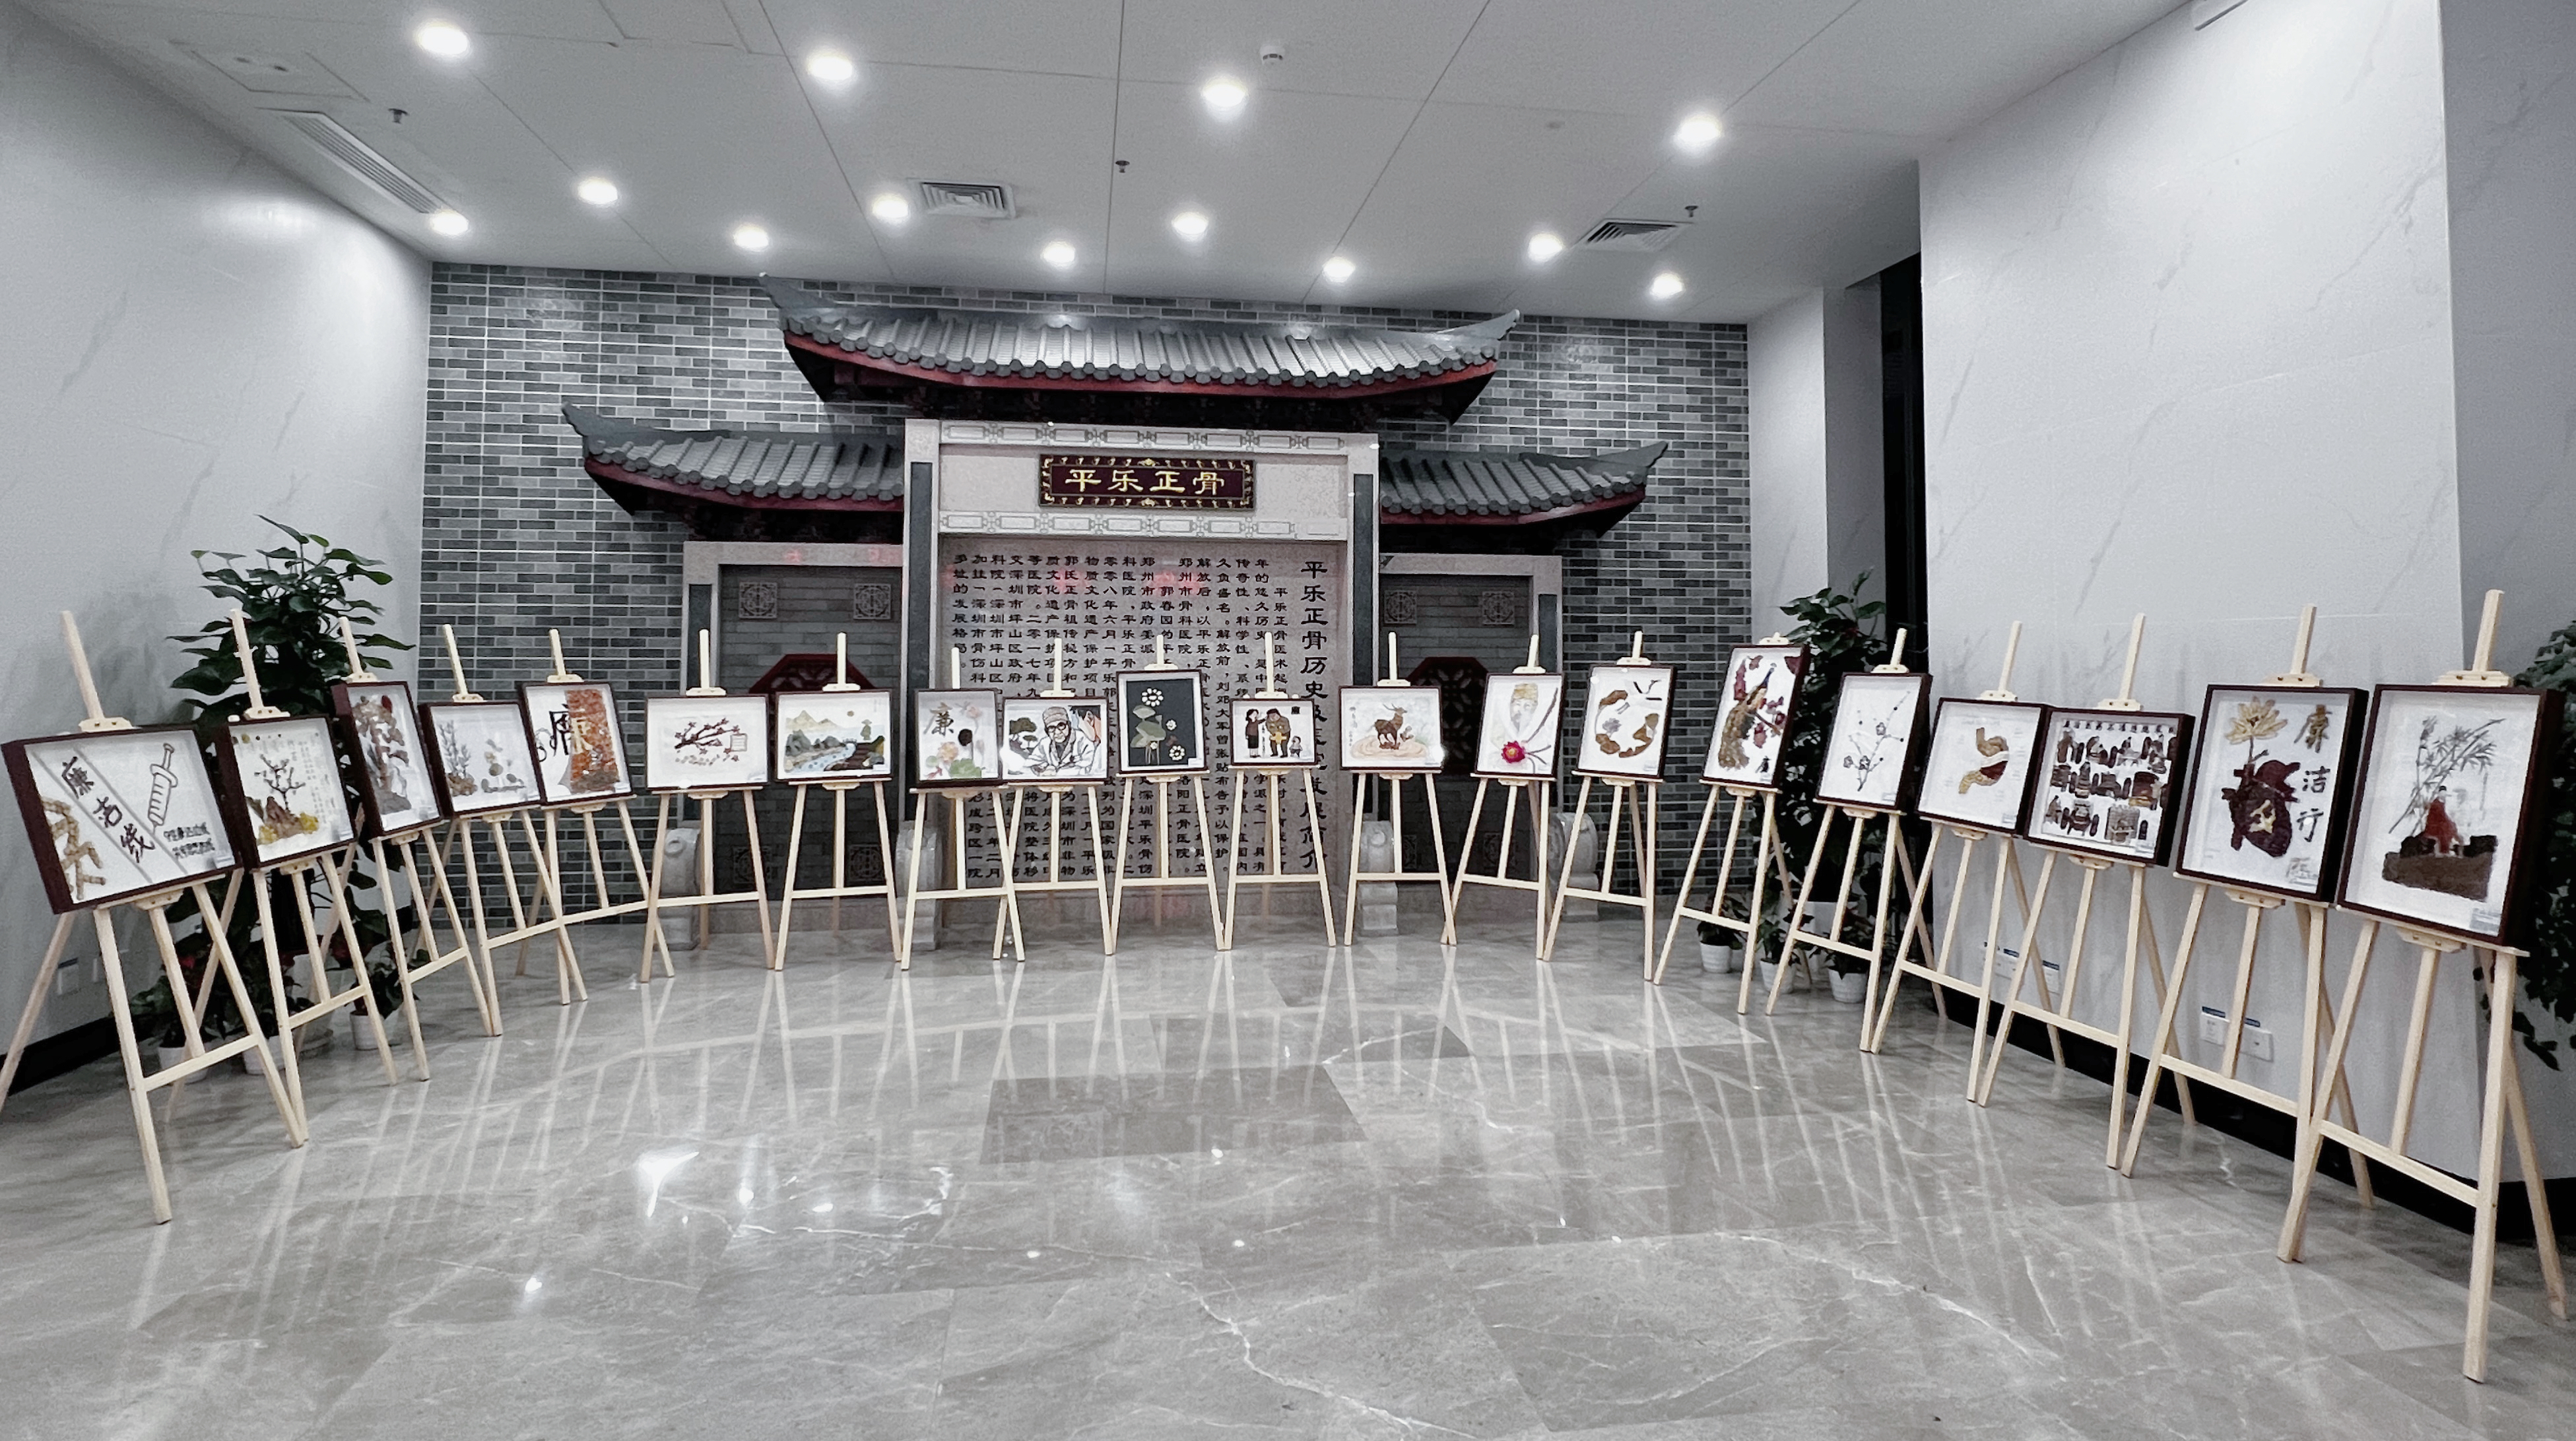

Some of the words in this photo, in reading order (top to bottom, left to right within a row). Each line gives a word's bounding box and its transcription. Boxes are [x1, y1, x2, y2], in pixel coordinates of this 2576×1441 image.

[1065, 468, 1226, 496] 平乐正骨
[923, 702, 954, 738] 廉
